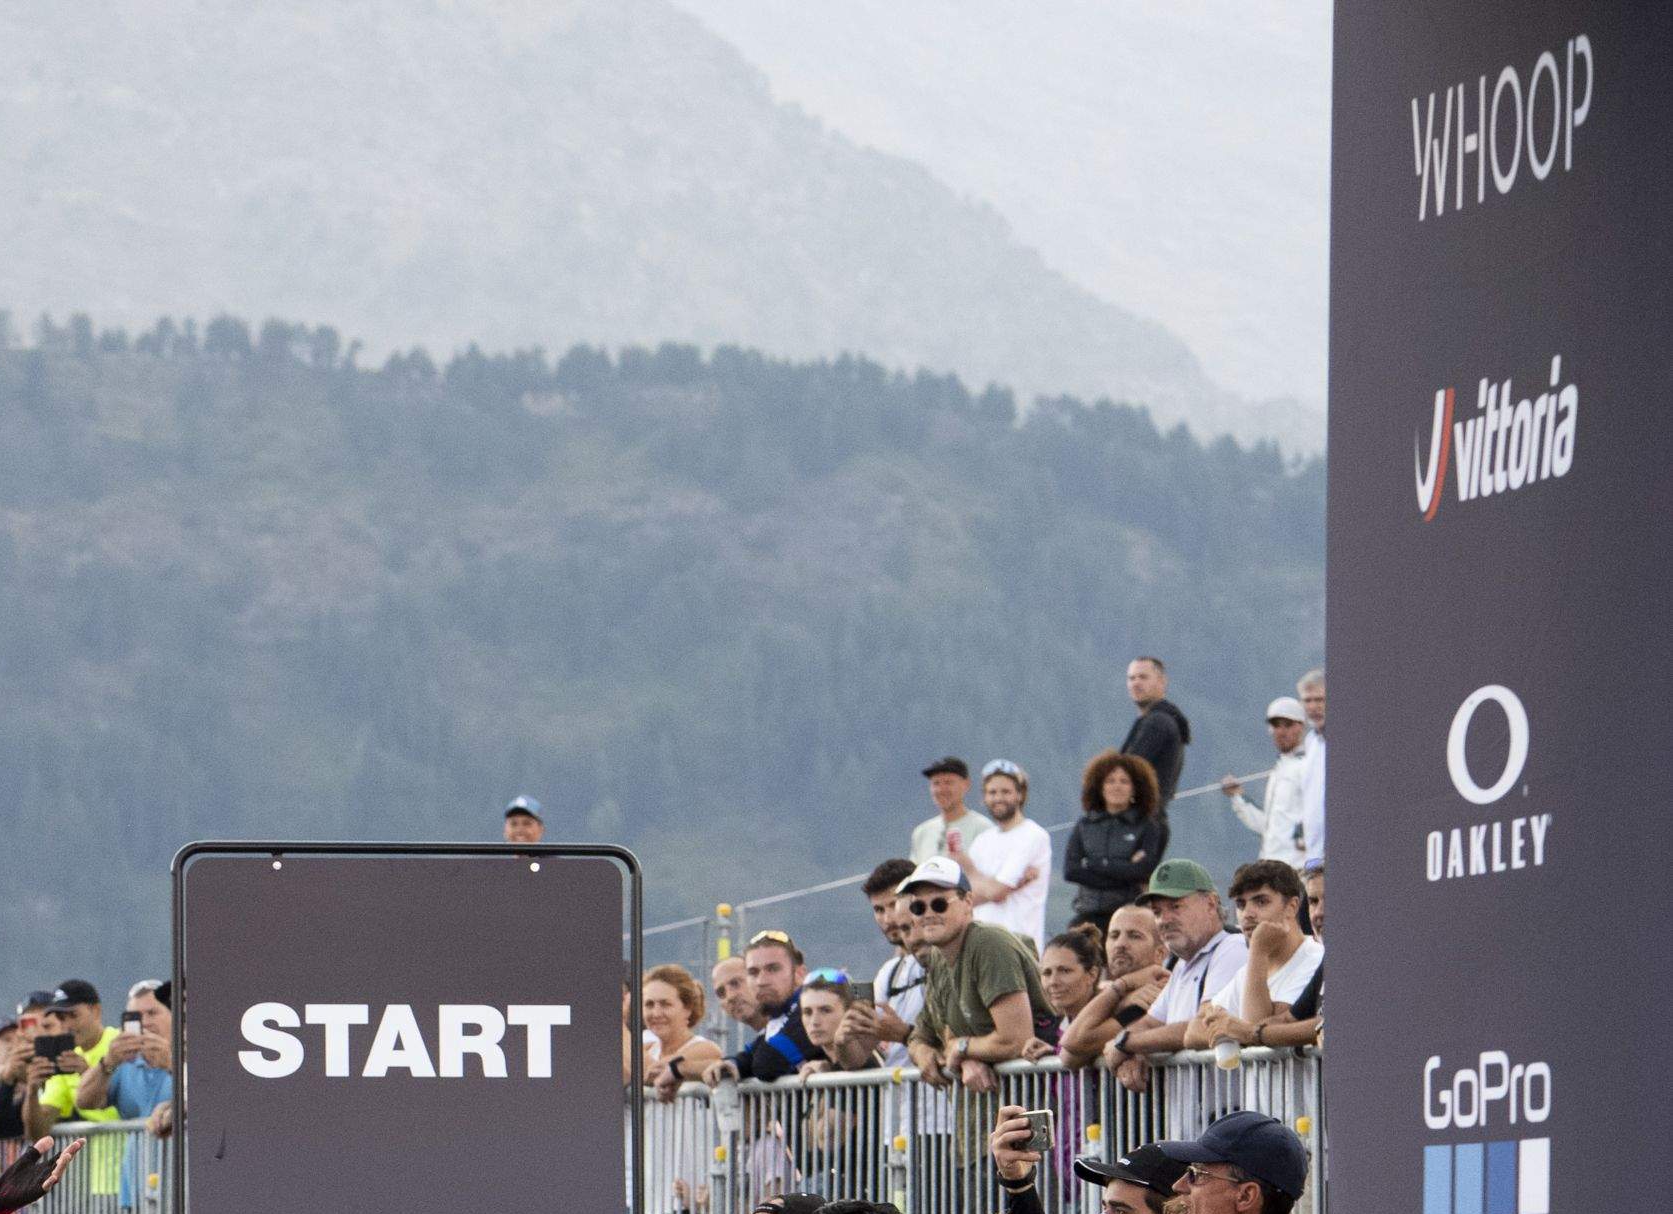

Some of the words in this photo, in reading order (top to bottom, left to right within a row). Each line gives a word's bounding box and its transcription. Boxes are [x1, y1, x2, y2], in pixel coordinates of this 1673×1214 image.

[1411, 34, 1593, 221] WHOOP
[1454, 354, 1578, 501] vittoria
[1427, 814, 1549, 881] OAKLEY
[237, 1002, 571, 1078] START
[1424, 1050, 1551, 1129] GoPro
